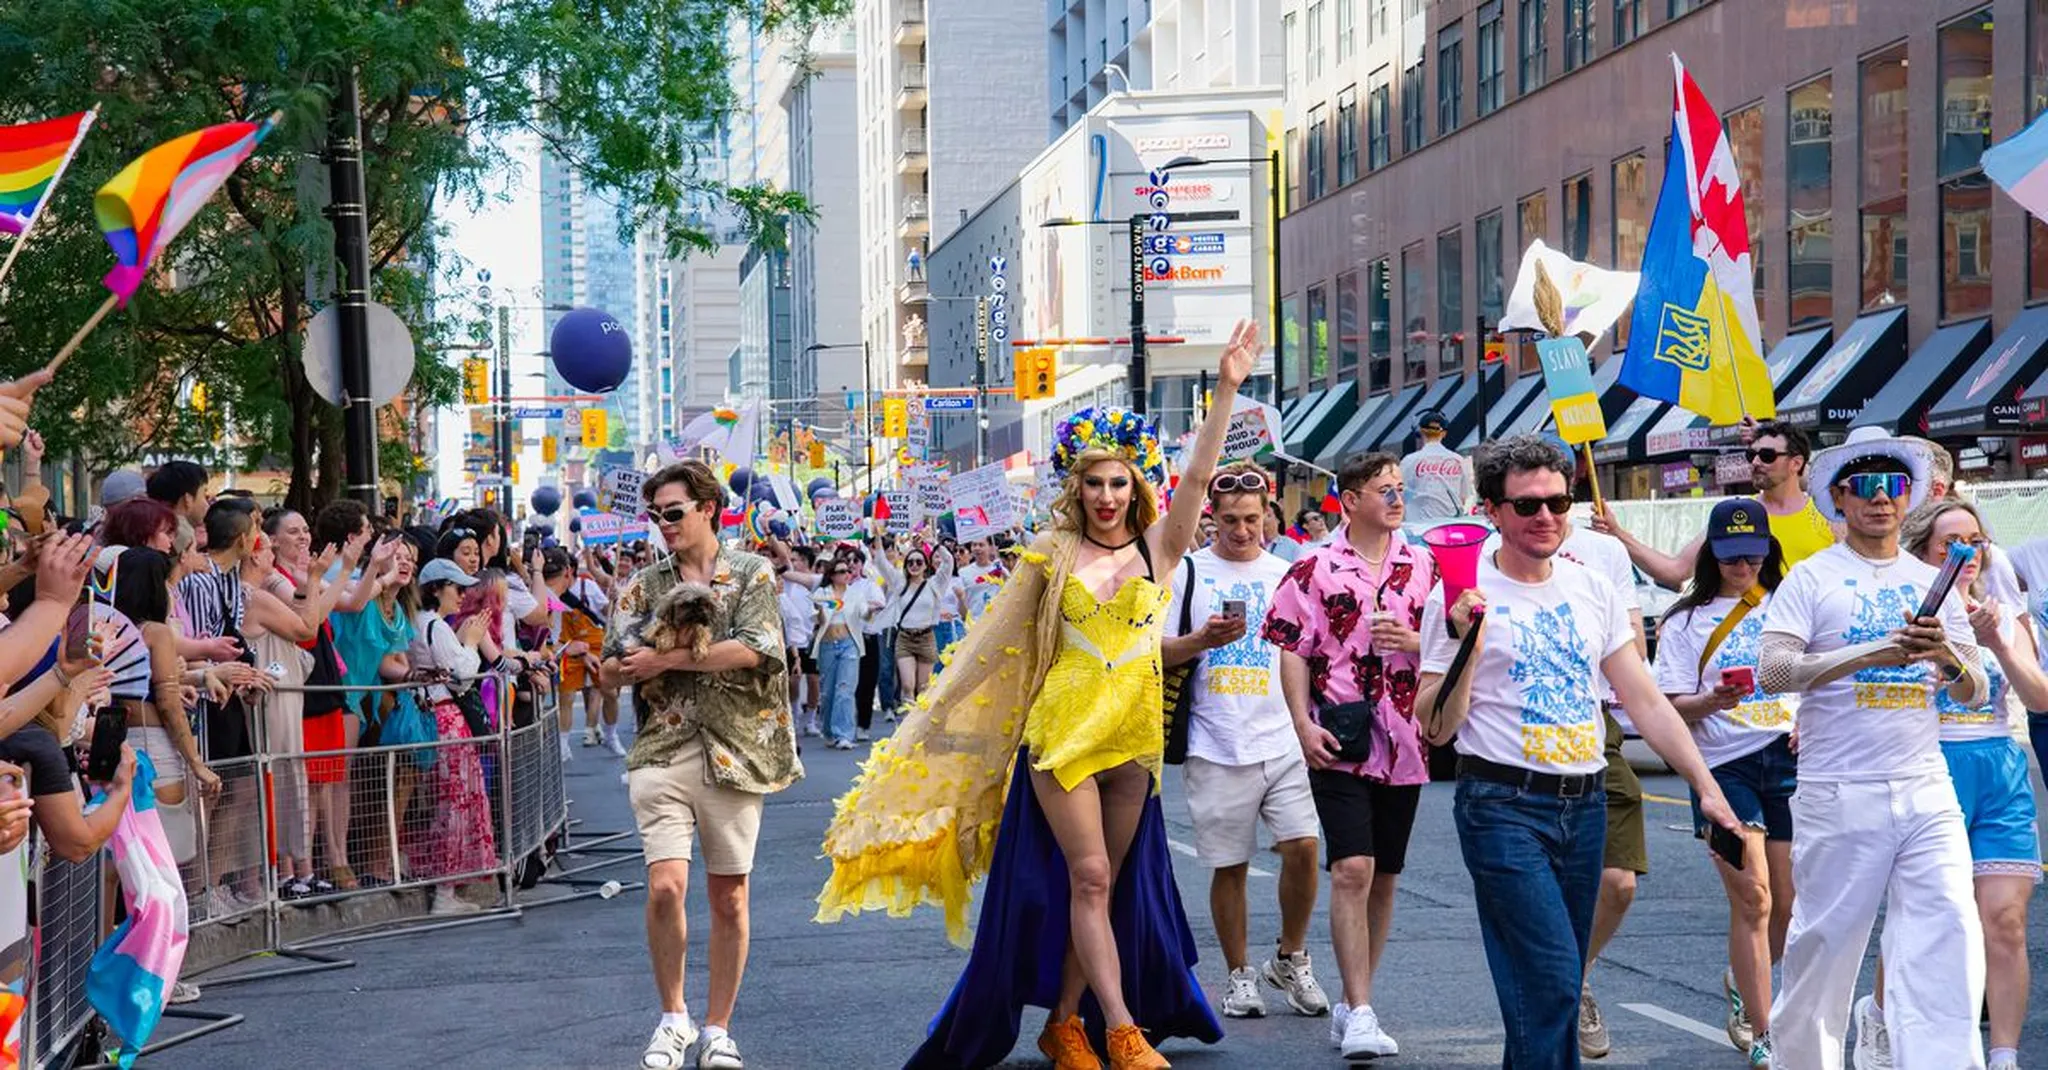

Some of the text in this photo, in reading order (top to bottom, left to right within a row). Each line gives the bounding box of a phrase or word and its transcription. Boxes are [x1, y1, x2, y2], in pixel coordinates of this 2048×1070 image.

[1135, 133, 1231, 156] pizza pizza
[1134, 183, 1215, 196] SHPPERS
[1134, 223, 1144, 302] DOWNTOWN
[1548, 347, 1584, 372] SLAVA
[1828, 408, 1863, 420] DUM
[1224, 430, 1249, 444] OUD
[1224, 437, 1260, 454] PROUD
[617, 482, 638, 494] KICK
[919, 484, 938, 492] PLAY
[610, 501, 637, 514] PRIDE
[825, 505, 845, 513] PLAY
[825, 514, 847, 522] LOUD
[825, 523, 854, 532] PROUD
